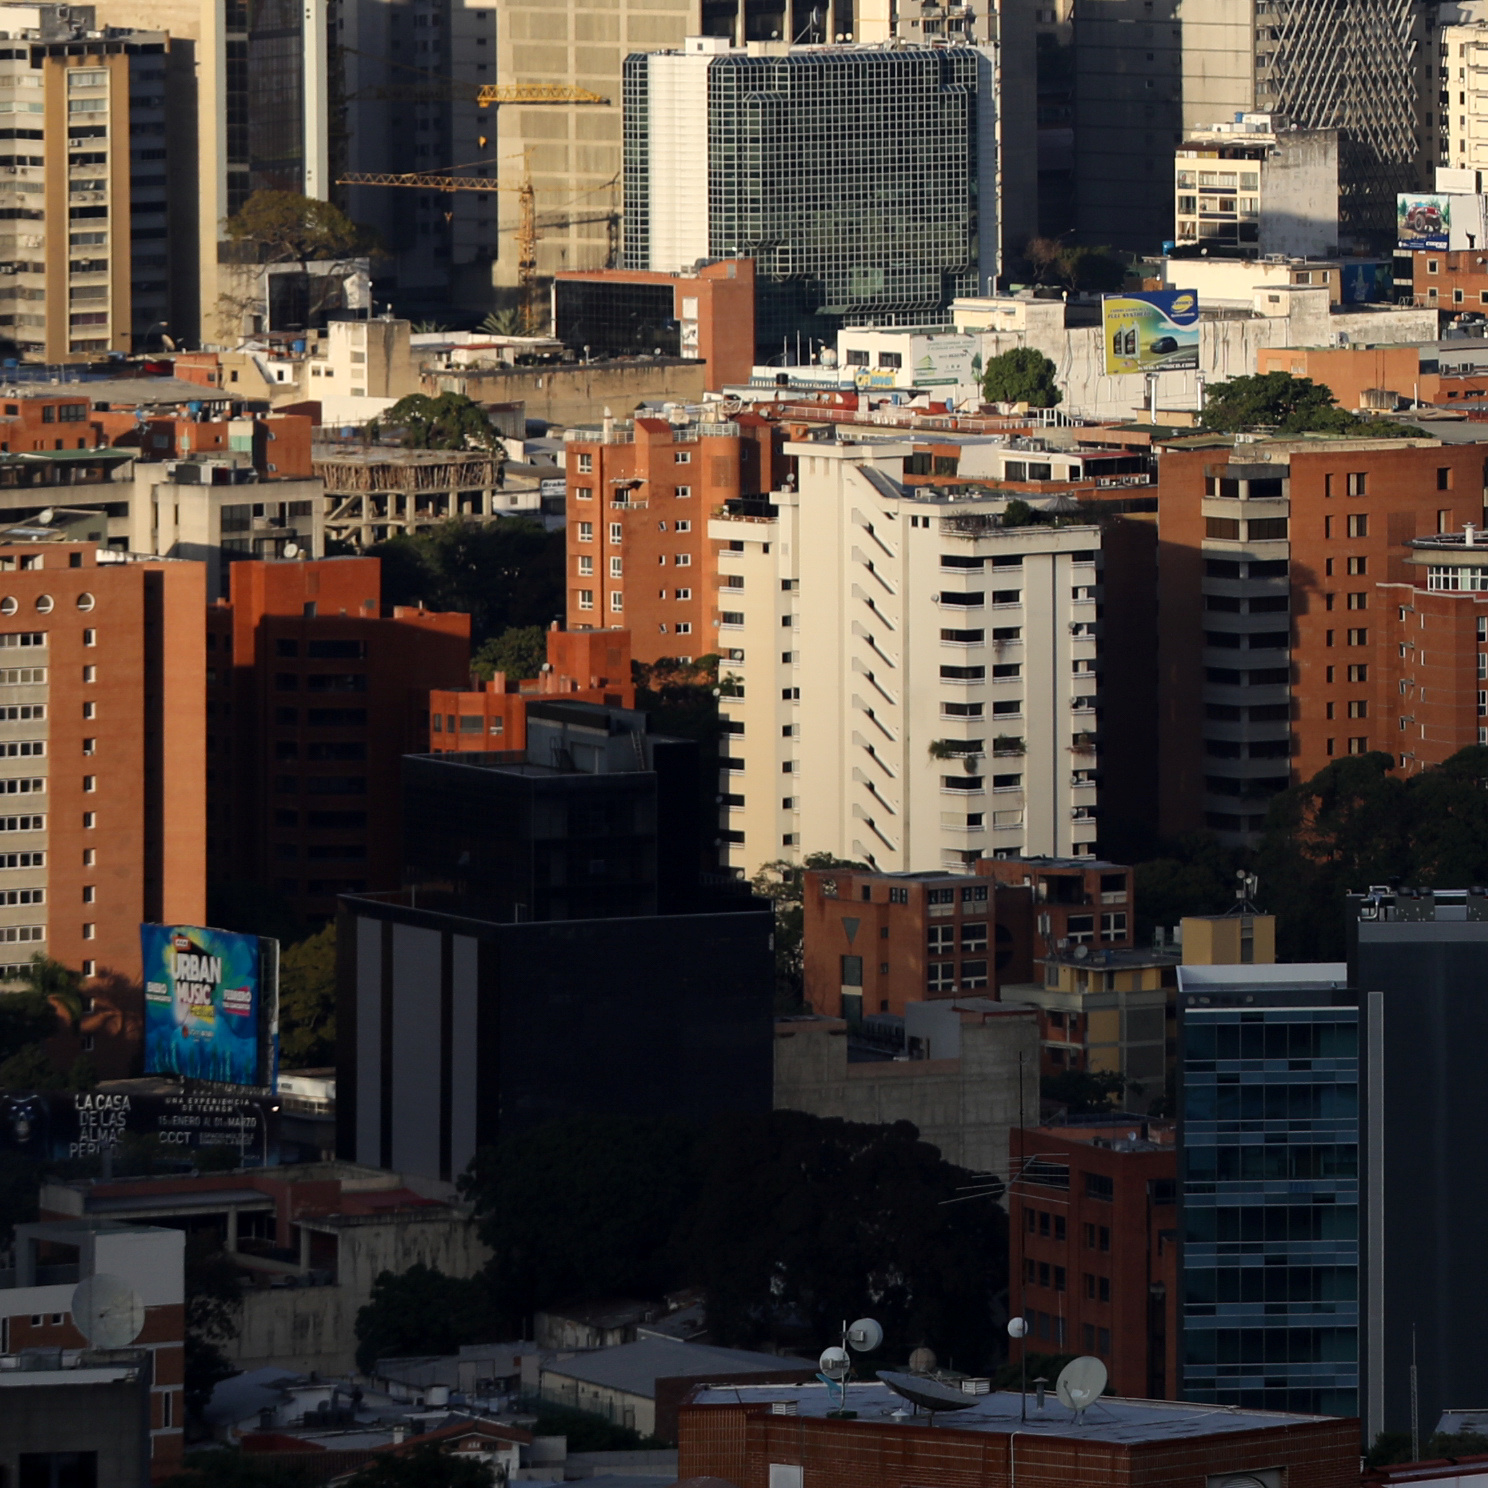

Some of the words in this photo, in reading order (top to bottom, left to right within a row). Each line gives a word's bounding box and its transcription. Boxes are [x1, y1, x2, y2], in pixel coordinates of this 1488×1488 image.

[170, 952, 222, 984] URBAN
[176, 981, 212, 1005] MUSIC
[75, 1094, 93, 1110] LA
[95, 1093, 131, 1111] CASA
[165, 1097, 184, 1105] UNA
[187, 1097, 250, 1106] EXPERIENCIA
[79, 1110, 98, 1126] DE
[100, 1111, 127, 1127] LAS
[172, 1115, 201, 1126] ENERO
[204, 1116, 211, 1125] AL
[227, 1117, 257, 1127] MARZO
[158, 1130, 192, 1144] CCCT
